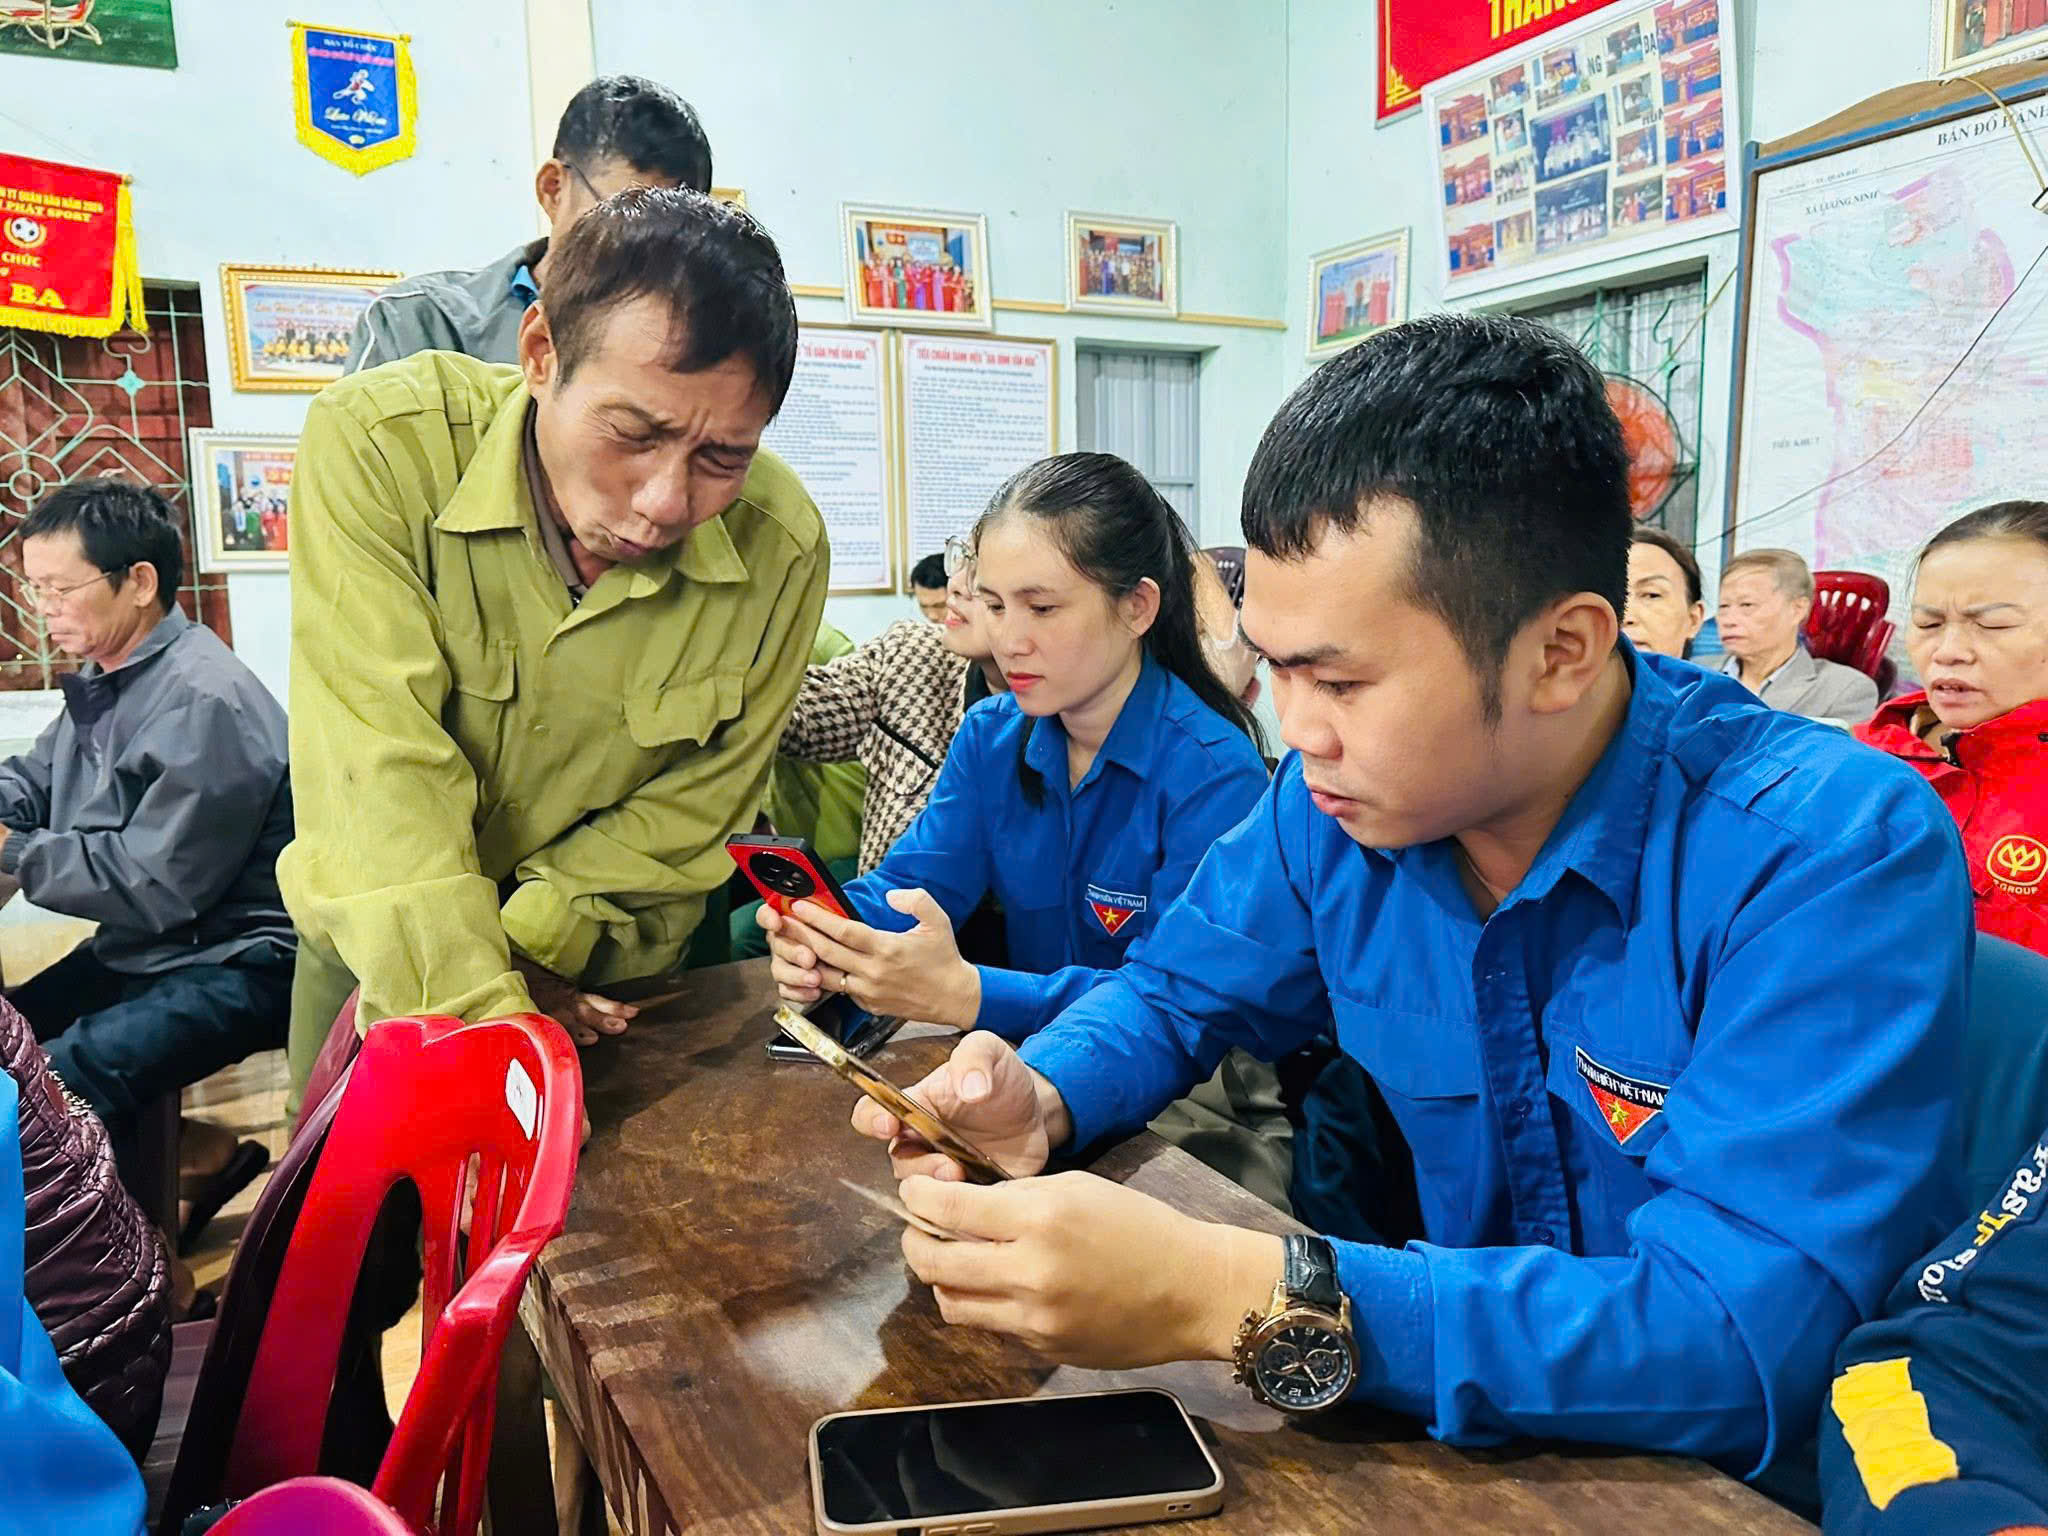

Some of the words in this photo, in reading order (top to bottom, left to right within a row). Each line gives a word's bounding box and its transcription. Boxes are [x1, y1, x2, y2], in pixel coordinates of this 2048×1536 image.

[1937, 124, 1969, 147] BẢN
[1974, 112, 1998, 137] ĐỒ
[5, 200, 45, 217] PHÁT
[47, 207, 92, 224] SPORT
[10, 282, 67, 310] BA
[2000, 882, 2038, 896] GROUP
